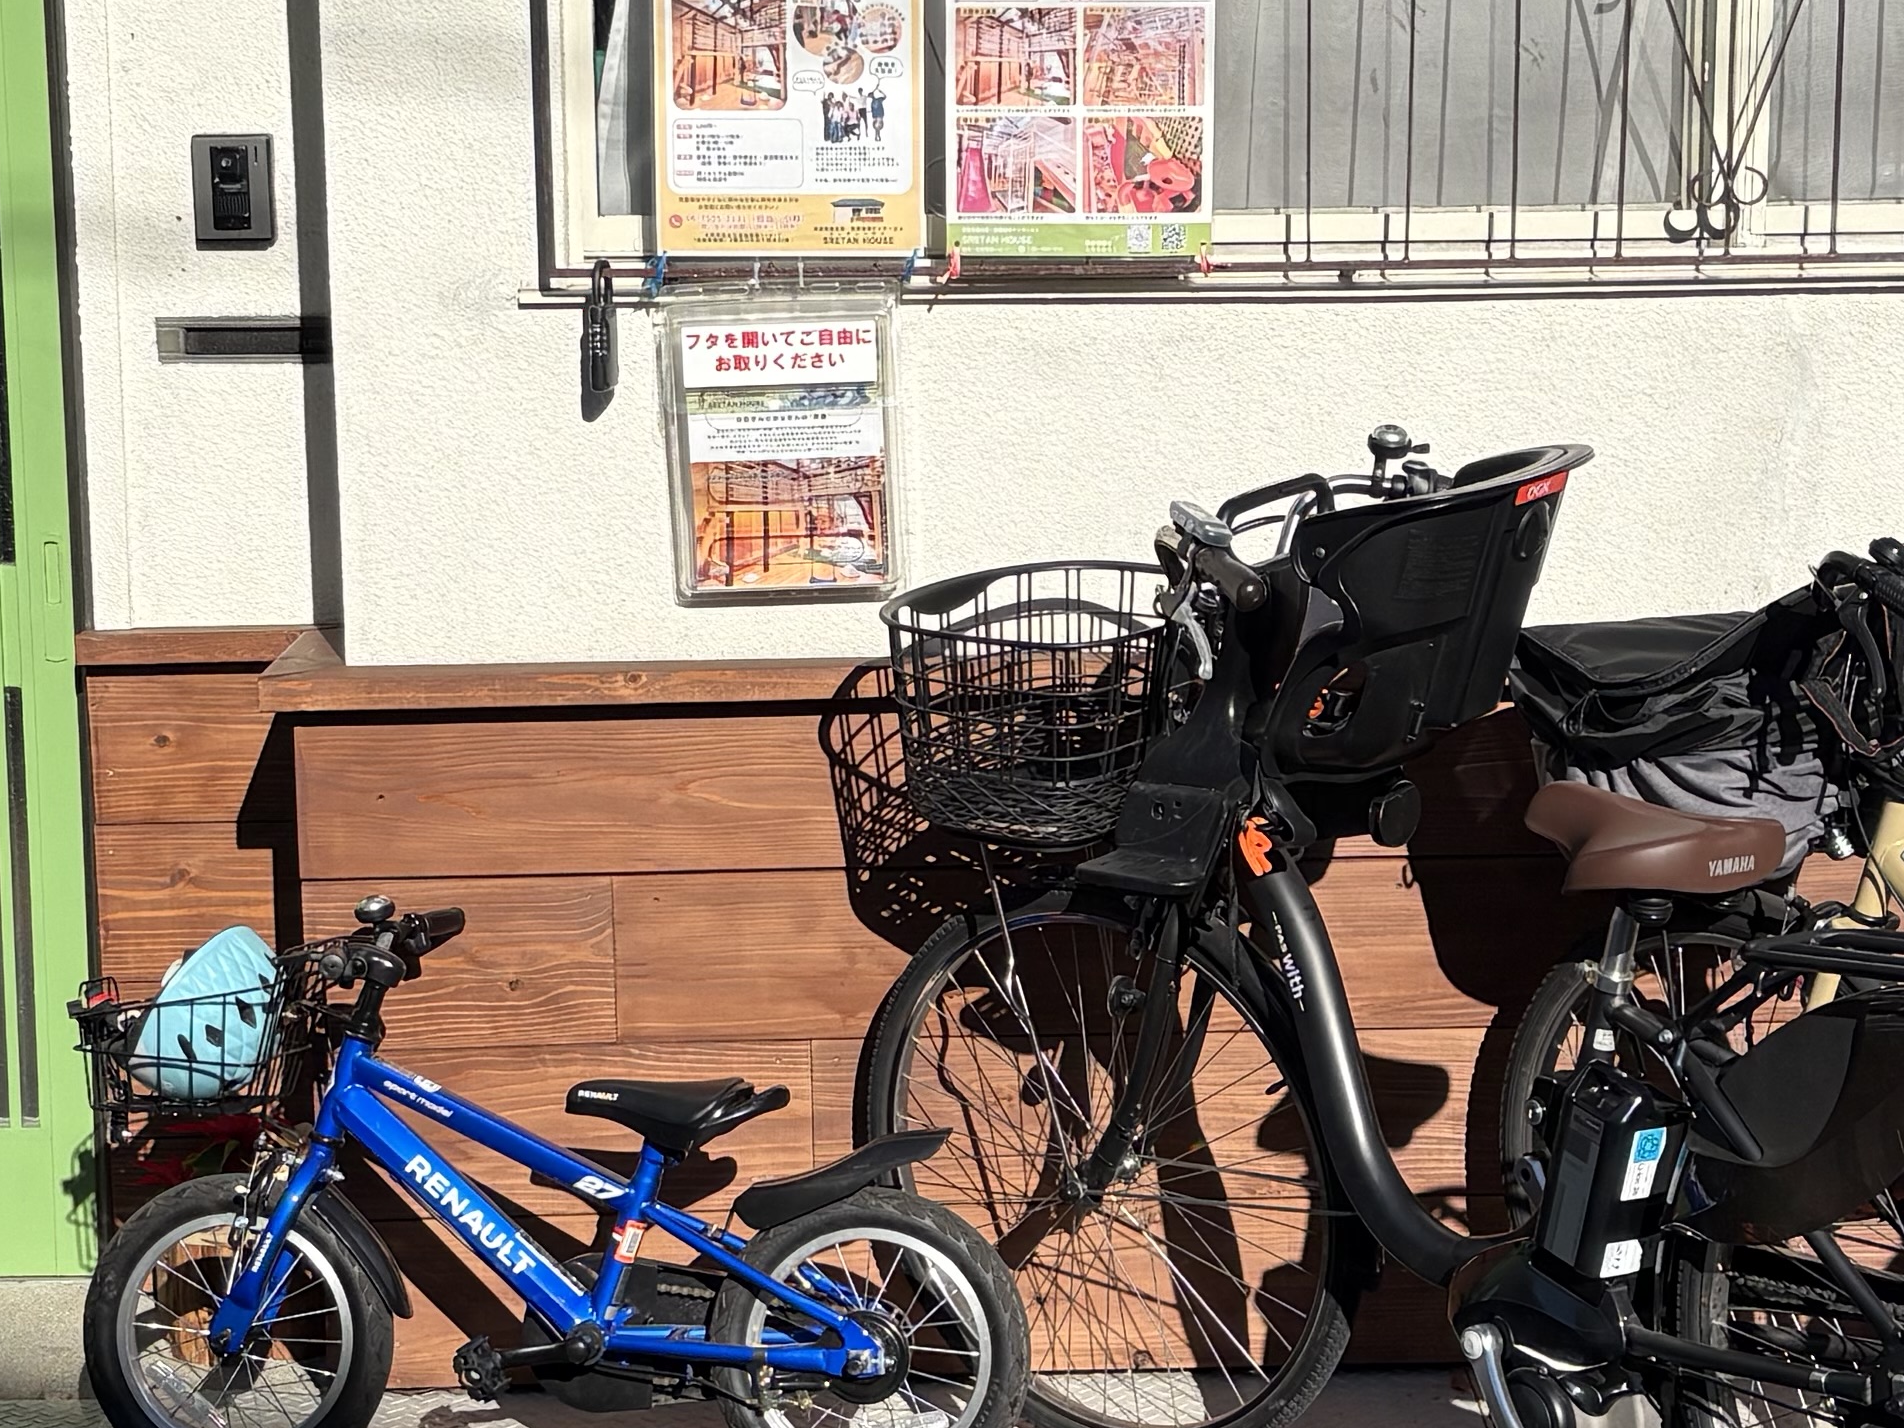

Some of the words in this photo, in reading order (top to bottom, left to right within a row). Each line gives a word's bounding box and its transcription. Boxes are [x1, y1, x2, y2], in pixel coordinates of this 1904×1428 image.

[686, 328, 872, 349] フタを開いてご自由に
[715, 352, 845, 372] お取りください
[1708, 855, 1755, 877] YAMAHA
[1282, 953, 1304, 999] with
[383, 1080, 417, 1100] sport
[416, 1097, 454, 1117] model
[572, 1175, 627, 1200] 27
[404, 1154, 536, 1276] RENAULT
